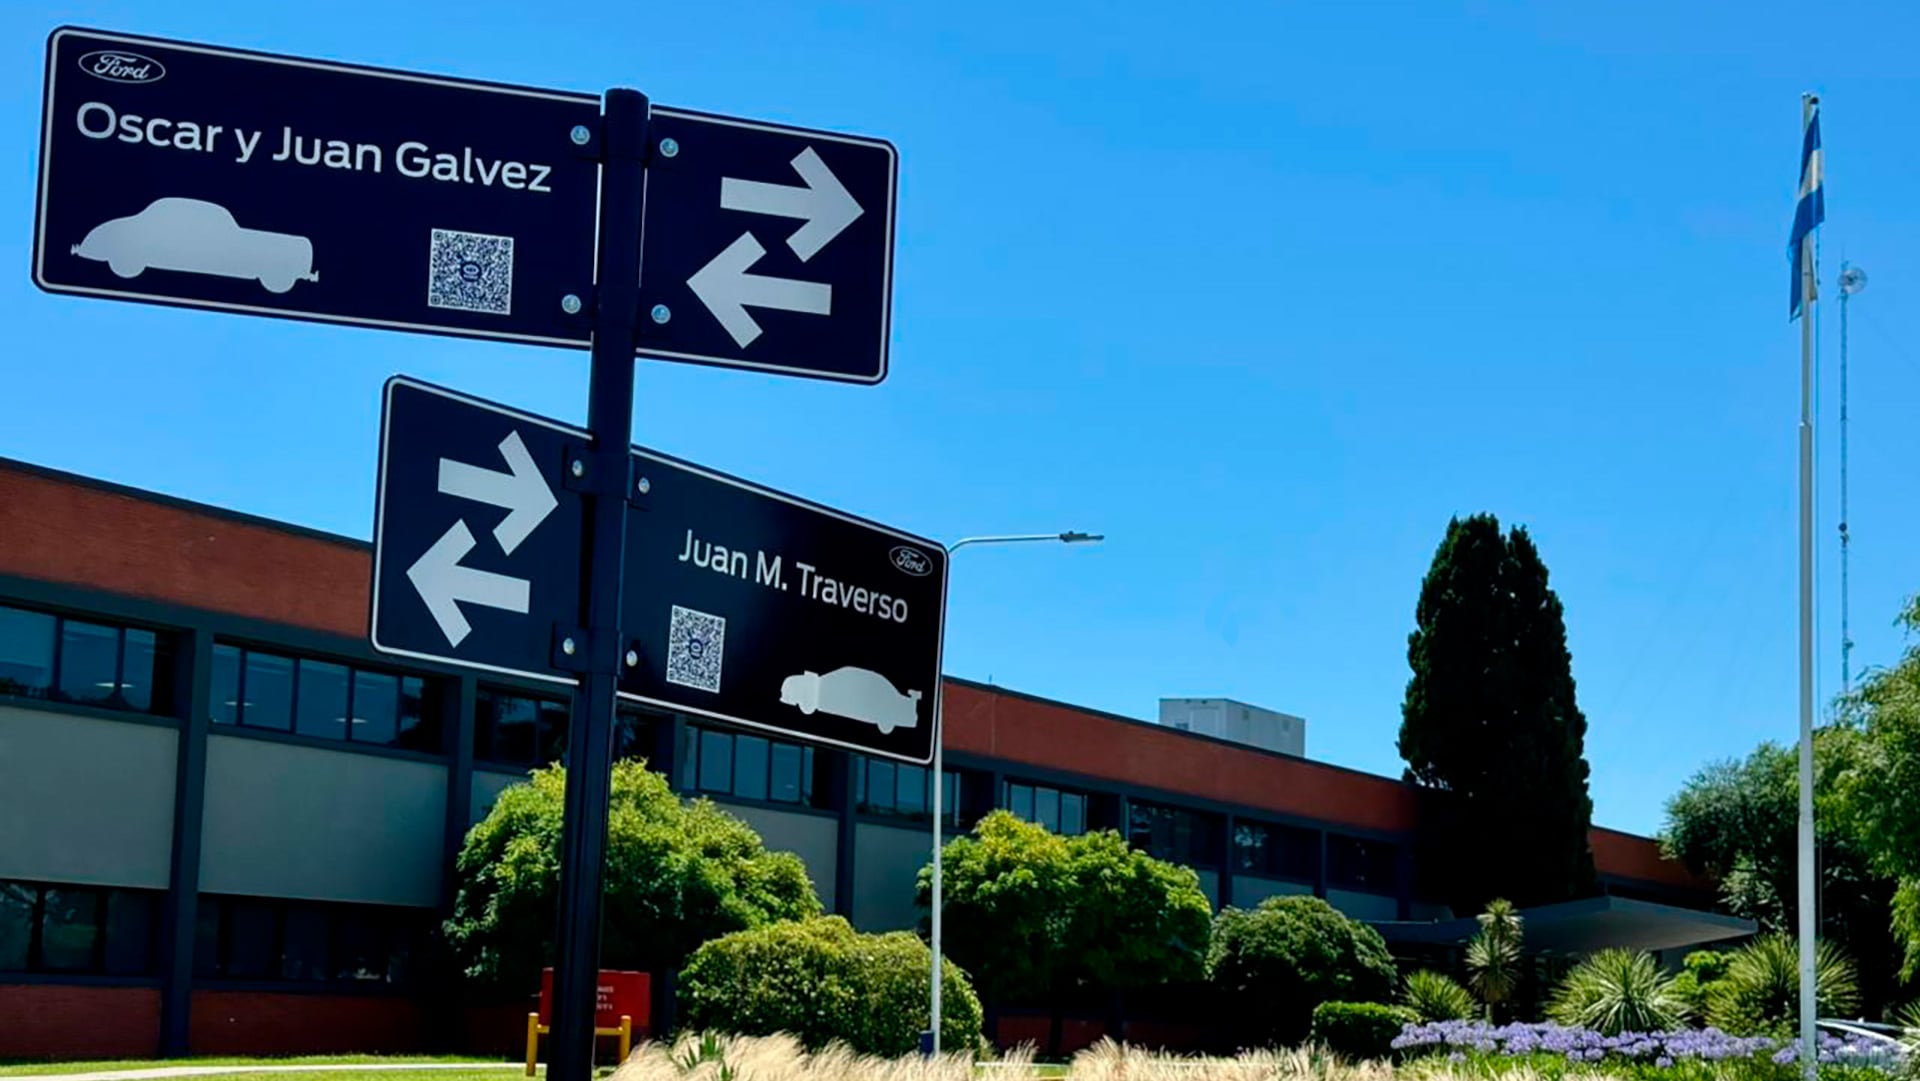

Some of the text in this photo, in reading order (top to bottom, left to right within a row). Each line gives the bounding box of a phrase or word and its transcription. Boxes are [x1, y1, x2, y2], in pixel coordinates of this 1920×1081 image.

[94, 54, 150, 79] Ford
[76, 101, 552, 193] Oscar y Juan Galvez
[678, 529, 909, 624] Juan M. Traverso
[896, 549, 926, 572] Ford
